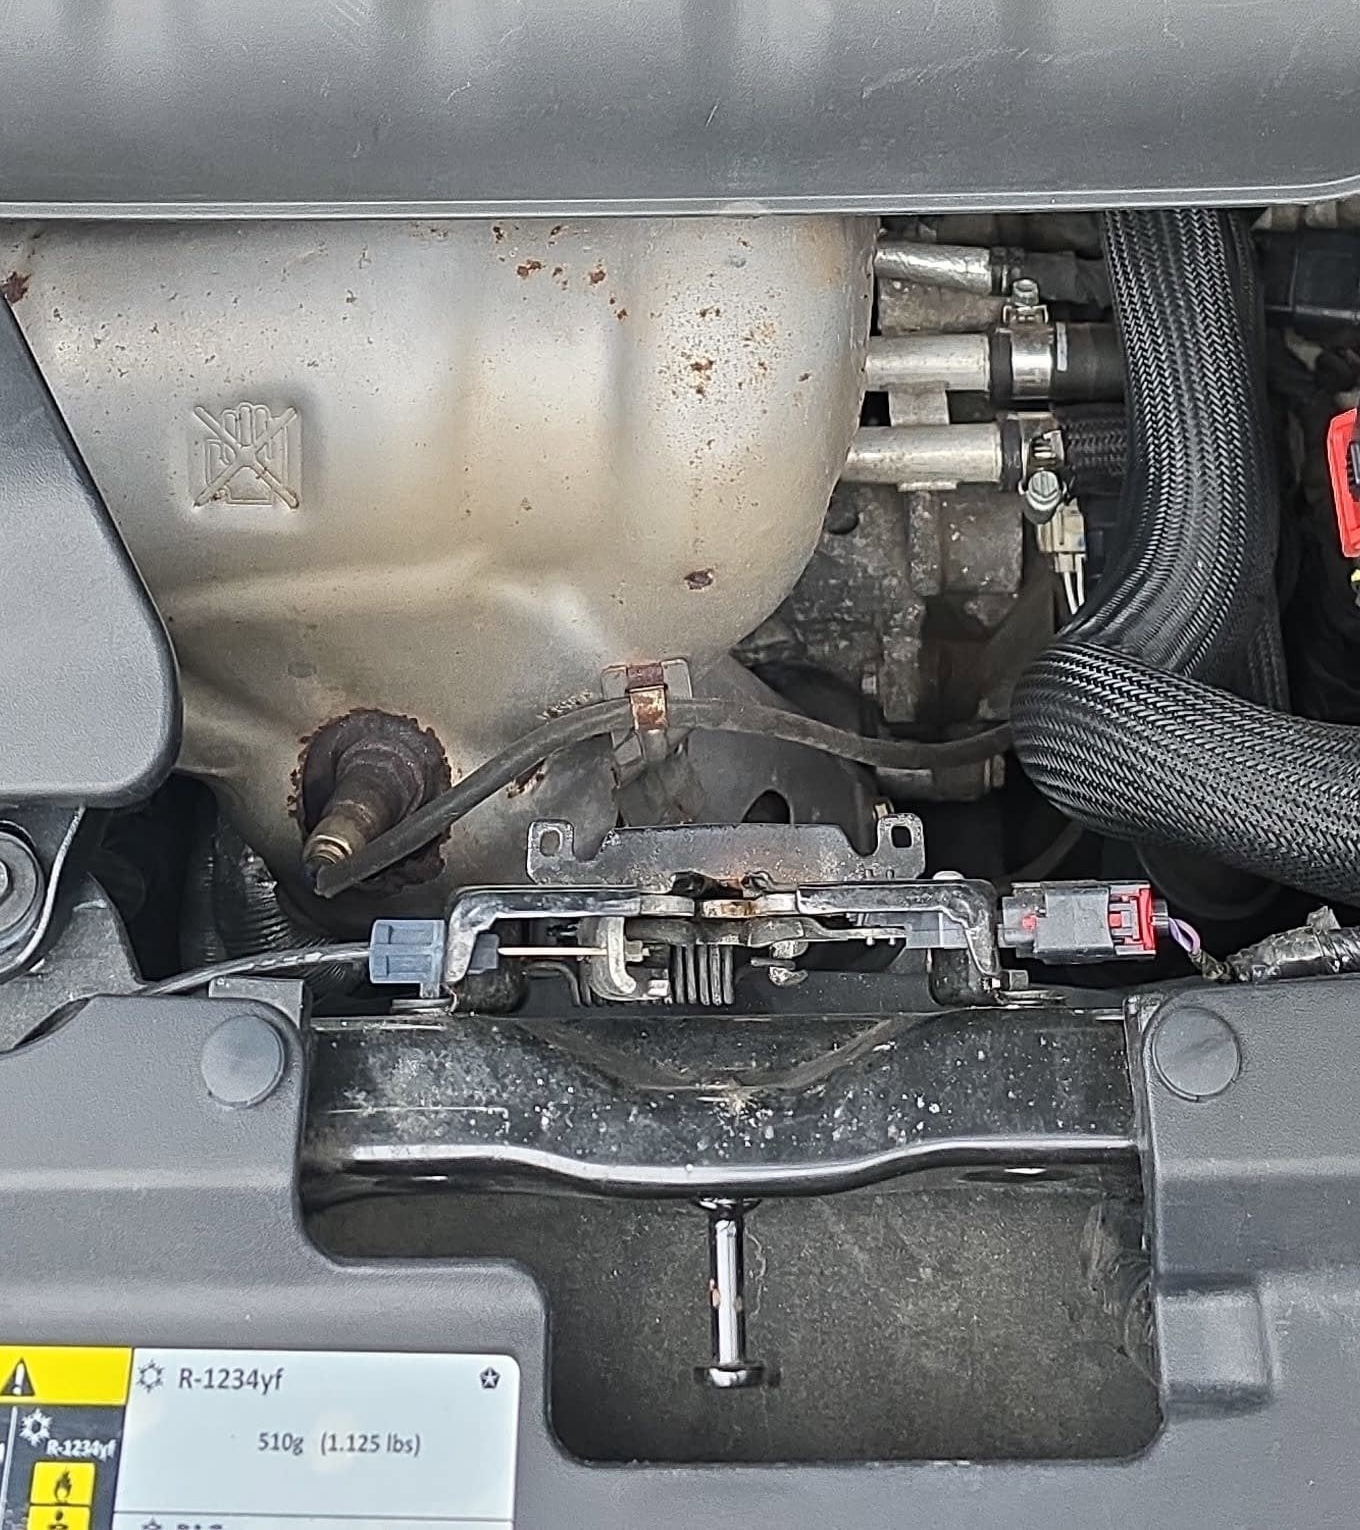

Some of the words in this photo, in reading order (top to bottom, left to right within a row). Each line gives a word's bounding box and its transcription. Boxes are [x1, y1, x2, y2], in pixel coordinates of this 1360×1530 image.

[177, 1366, 285, 1395] R-1234yf
[45, 1438, 117, 1461] R-1234yf
[257, 1432, 305, 1456] 510g
[320, 1433, 381, 1457] (1.125
[386, 1432, 422, 1457] lbs)
